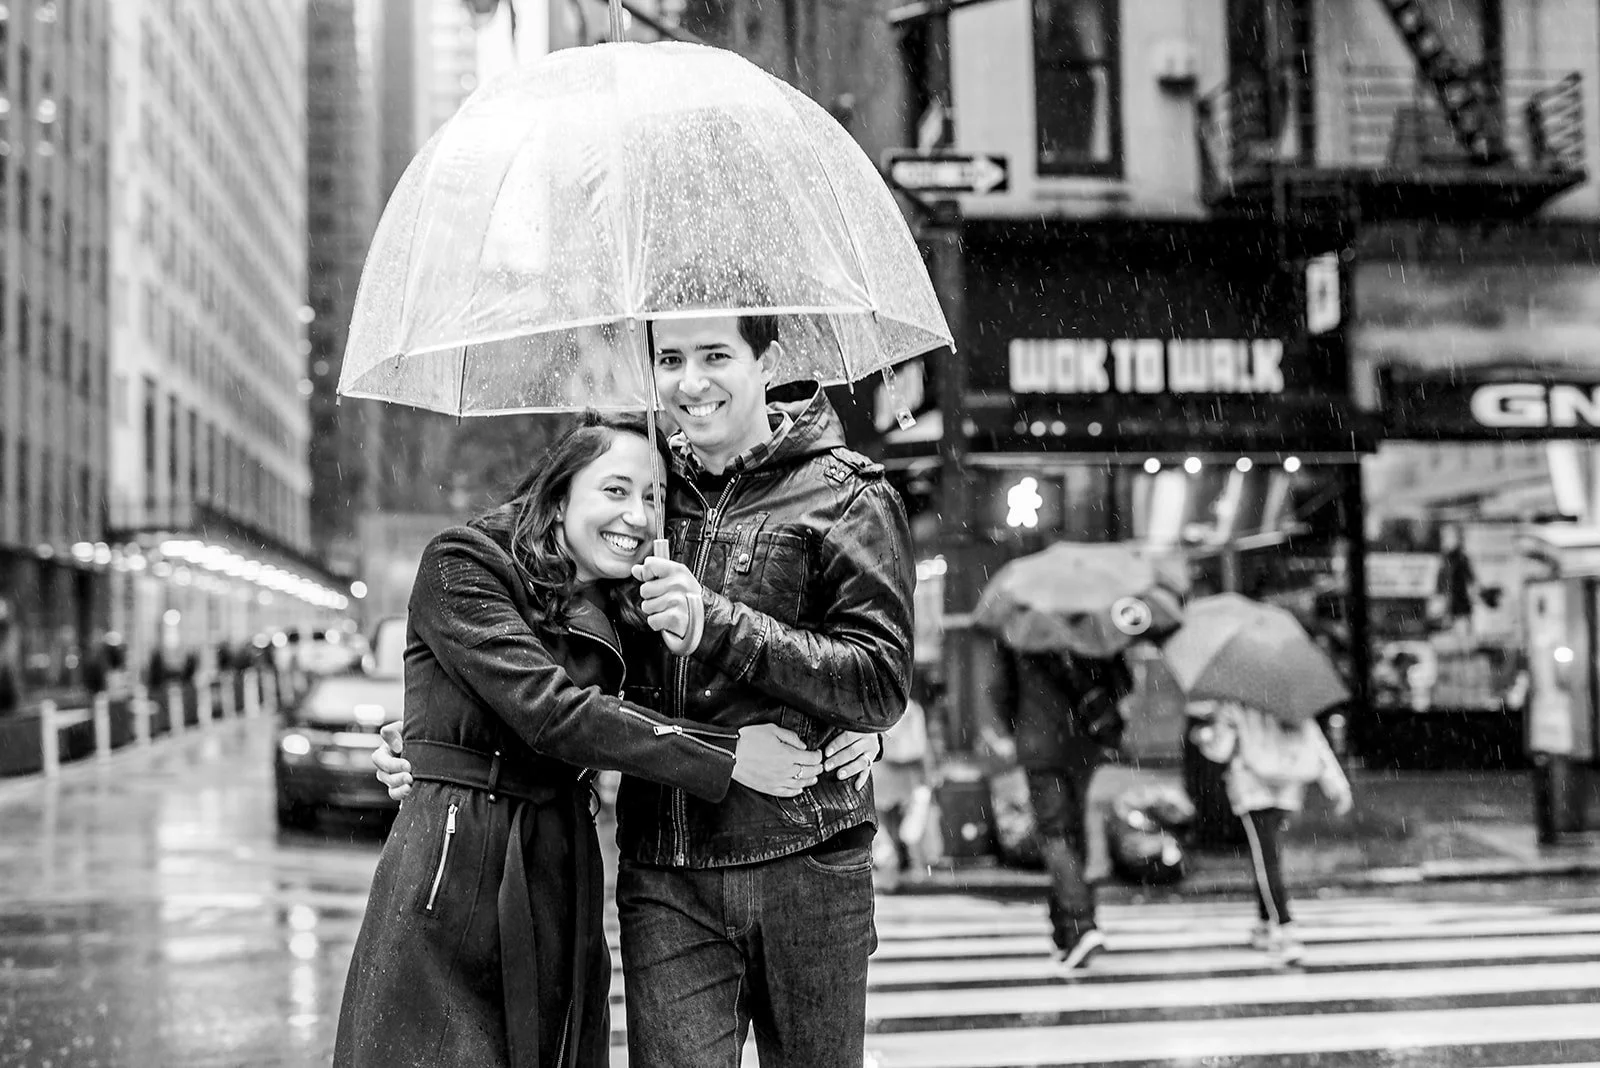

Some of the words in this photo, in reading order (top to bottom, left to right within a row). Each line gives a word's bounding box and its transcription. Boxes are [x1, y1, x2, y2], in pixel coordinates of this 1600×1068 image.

[1009, 338, 1109, 393] WOK
[1111, 338, 1164, 393] TO
[1167, 338, 1284, 393] WALK
